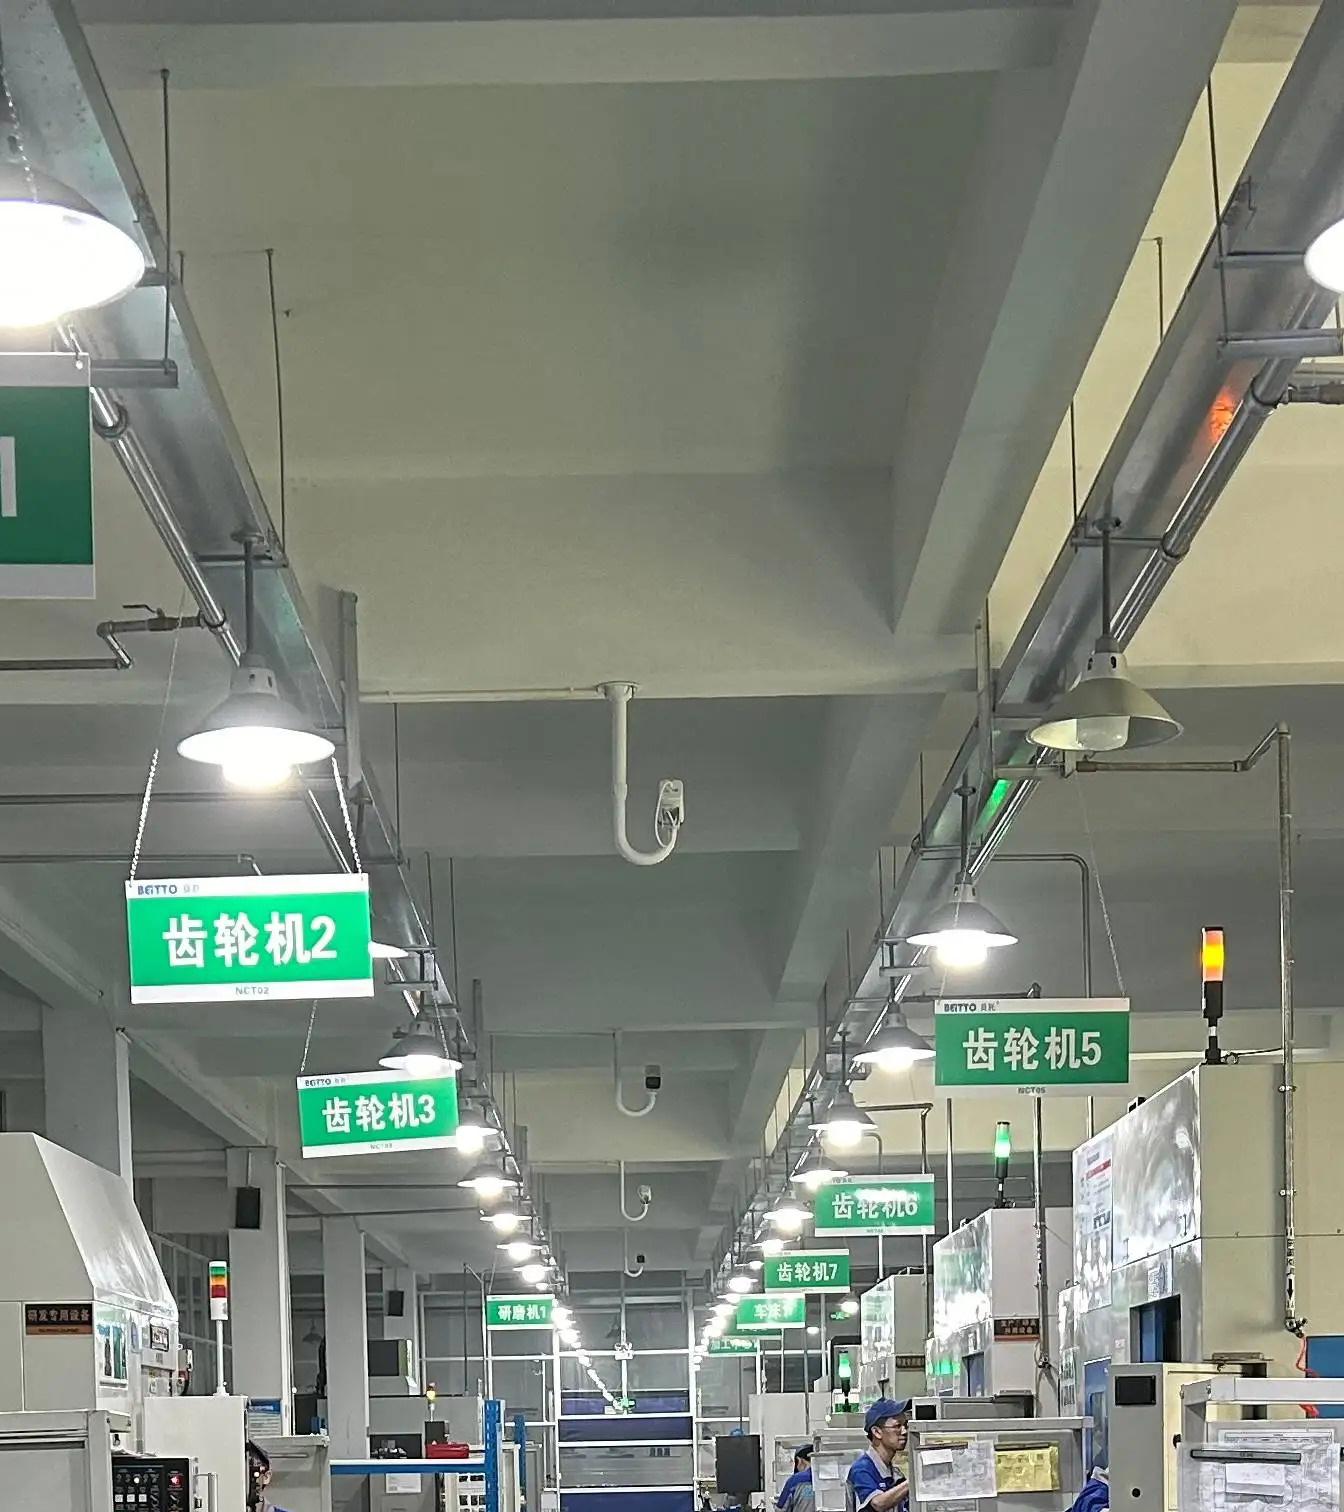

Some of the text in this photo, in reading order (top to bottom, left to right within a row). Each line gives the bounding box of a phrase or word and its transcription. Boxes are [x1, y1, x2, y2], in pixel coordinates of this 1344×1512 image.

[162, 911, 338, 968] 齿轮机2
[235, 986, 270, 995] NCT02
[962, 1026, 1102, 1071] 齿轮机5
[322, 1092, 436, 1133] 齿轮机3
[776, 1262, 838, 1282] 齿轮机7
